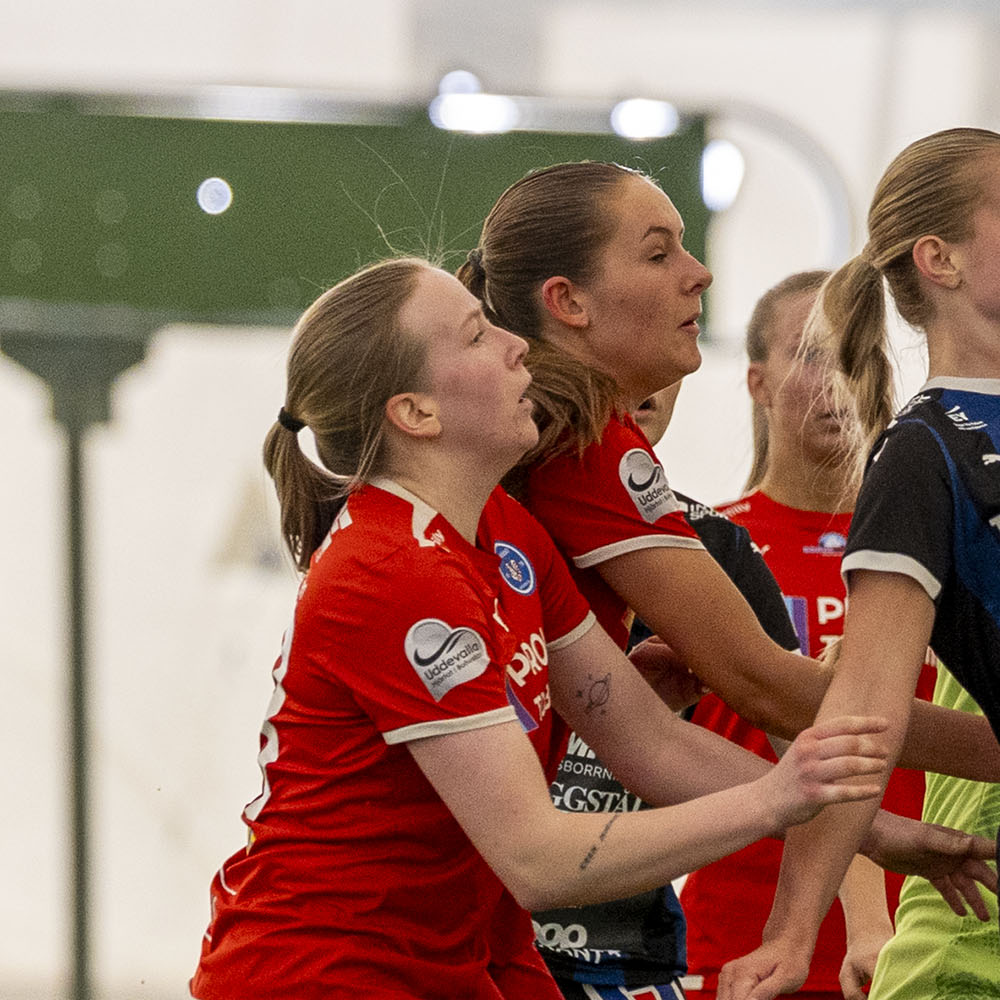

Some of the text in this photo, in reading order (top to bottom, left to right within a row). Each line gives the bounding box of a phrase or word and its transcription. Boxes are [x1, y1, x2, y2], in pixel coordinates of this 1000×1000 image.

[424, 642, 480, 681] Uddevalla
[506, 628, 548, 687] PRO
[558, 760, 616, 780] BORRN
